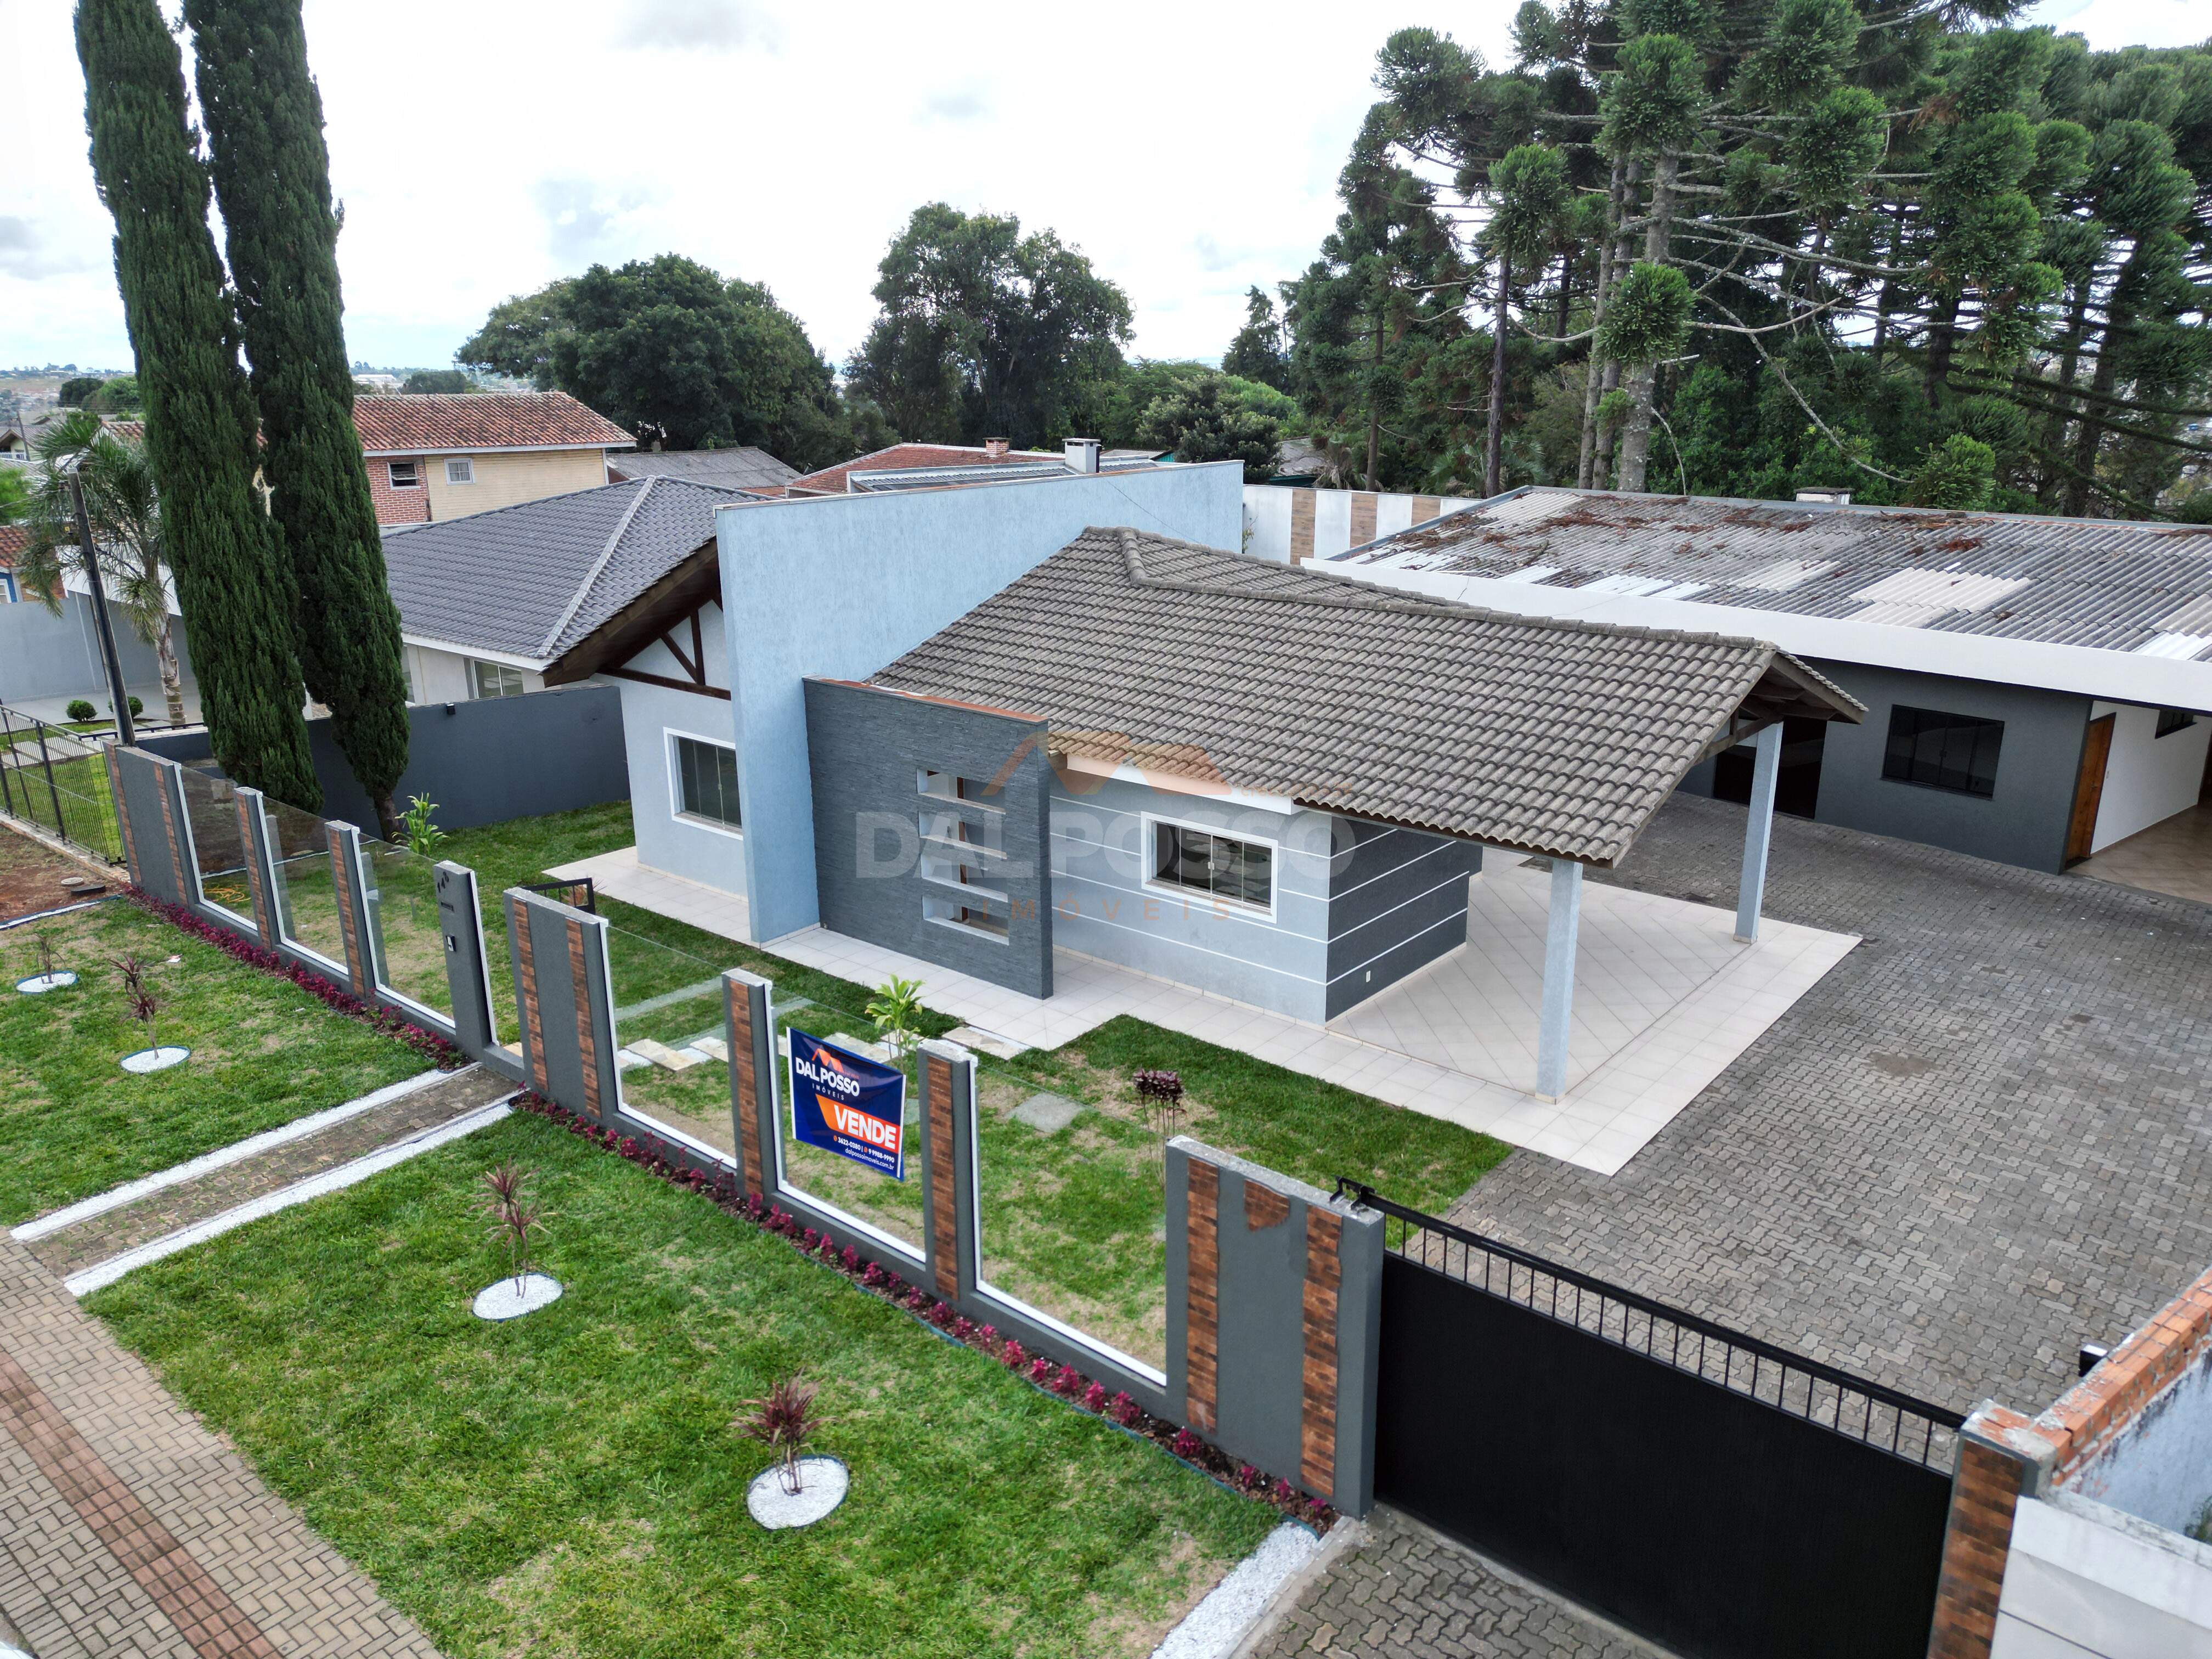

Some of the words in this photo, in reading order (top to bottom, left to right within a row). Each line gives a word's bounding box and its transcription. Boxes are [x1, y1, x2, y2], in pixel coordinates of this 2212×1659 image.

[437, 871, 449, 893] 148
[795, 1057, 820, 1082] DAL
[821, 1067, 860, 1097] POSSO
[812, 1083, 844, 1100] IMÓVEIS
[834, 1104, 896, 1150] VENDE
[845, 1148, 894, 1170] dalpossoimoveis.com.br
